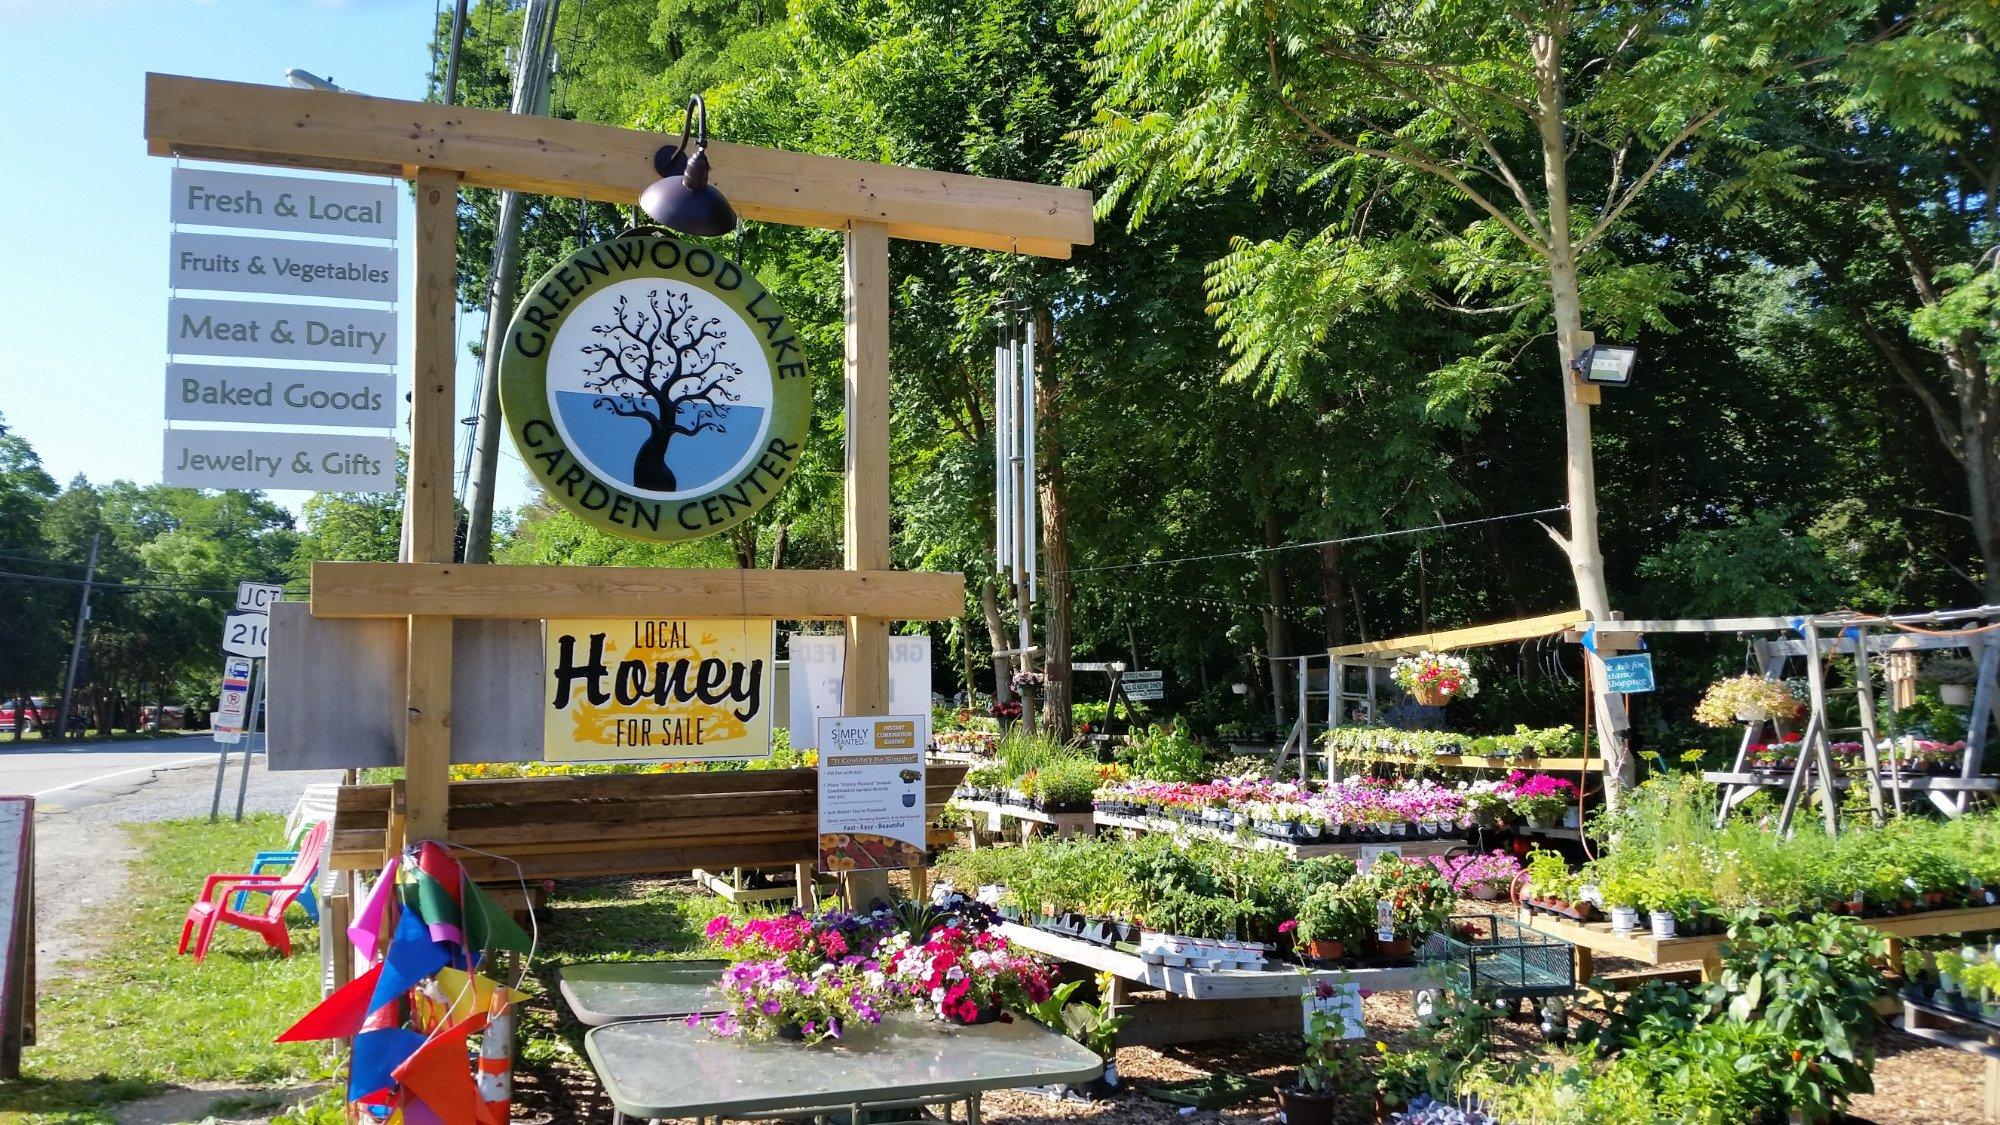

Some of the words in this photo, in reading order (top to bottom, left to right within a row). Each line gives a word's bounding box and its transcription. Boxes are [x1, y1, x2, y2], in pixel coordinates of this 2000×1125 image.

[187, 185, 263, 215] Fresh
[273, 193, 298, 217] &
[309, 196, 382, 224] Local
[180, 251, 239, 273] Fruits
[247, 255, 265, 275] &
[273, 257, 389, 284] Vegetables
[515, 238, 743, 358] GREENWOOD
[180, 314, 260, 342] Meat
[270, 319, 295, 344] &
[306, 321, 386, 354] Dairy
[745, 291, 807, 380] LAKE
[182, 378, 272, 407] Baked
[284, 383, 382, 411] Goods
[177, 448, 281, 477] Jewelry
[290, 451, 313, 474] &
[321, 451, 381, 476] Gifts
[522, 418, 661, 532] GARDEN
[677, 436, 800, 531] CENTER
[241, 587, 279, 607] JCT
[634, 620, 691, 650] LOCAL
[552, 632, 764, 723] Honey
[616, 718, 652, 748] FOR
[661, 716, 704, 747] SALE
[831, 728, 869, 740] SIMPLY
[833, 738, 865, 746] PLANTED
[860, 823, 874, 831] Easy
